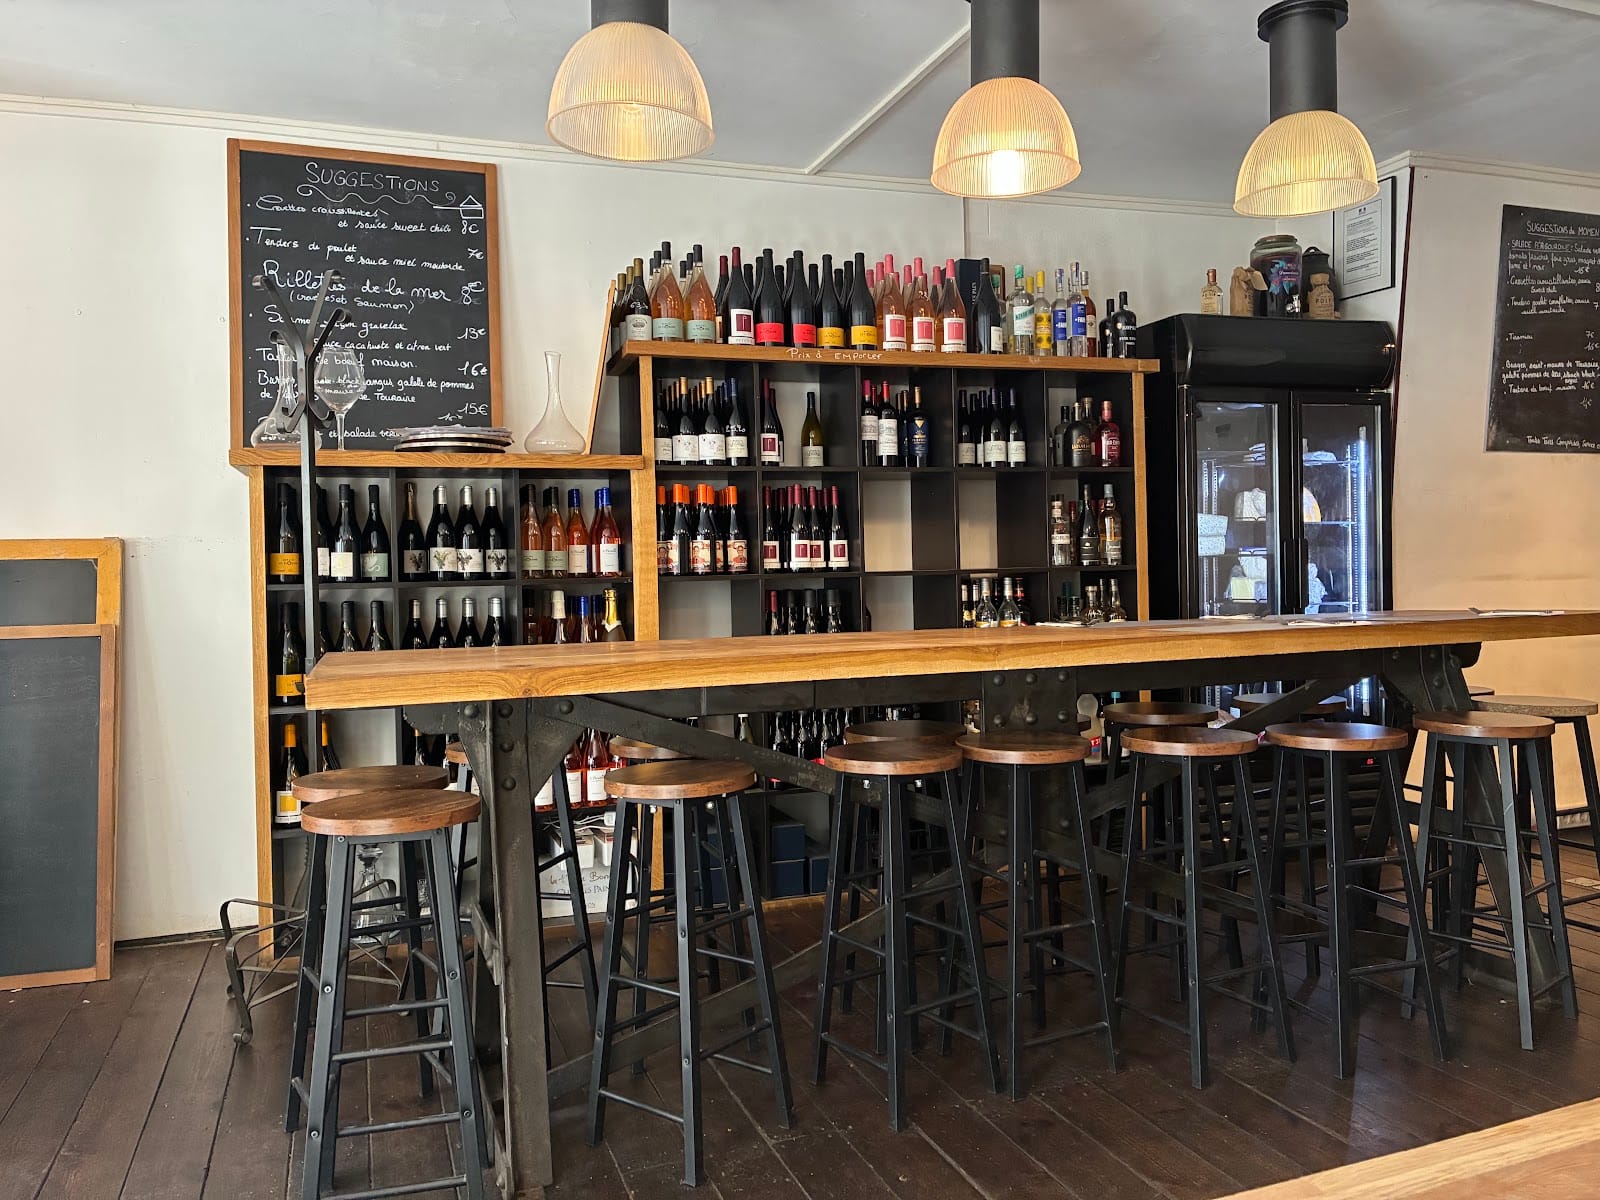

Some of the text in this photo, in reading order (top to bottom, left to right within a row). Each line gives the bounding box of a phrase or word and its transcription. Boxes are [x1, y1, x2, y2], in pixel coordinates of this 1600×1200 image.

[355, 221, 387, 231] sauce
[391, 222, 426, 233] sweet
[461, 219, 480, 235] 8€
[1526, 221, 1569, 234] SUGGESTIONS
[249, 226, 300, 248] Tenders
[326, 242, 358, 260] poulet
[467, 247, 484, 260] 7€
[344, 254, 466, 271] et sauce miel moutarde
[361, 278, 381, 293] de
[385, 277, 405, 296] la
[461, 281, 485, 305] 8€
[406, 340, 431, 352] citron
[435, 344, 452, 352] vert
[786, 347, 811, 359] Prix
[458, 360, 489, 376] 16€
[260, 387, 273, 398] de
[427, 378, 438, 388] de
[440, 380, 475, 393] pommes
[458, 402, 489, 416] 15€
